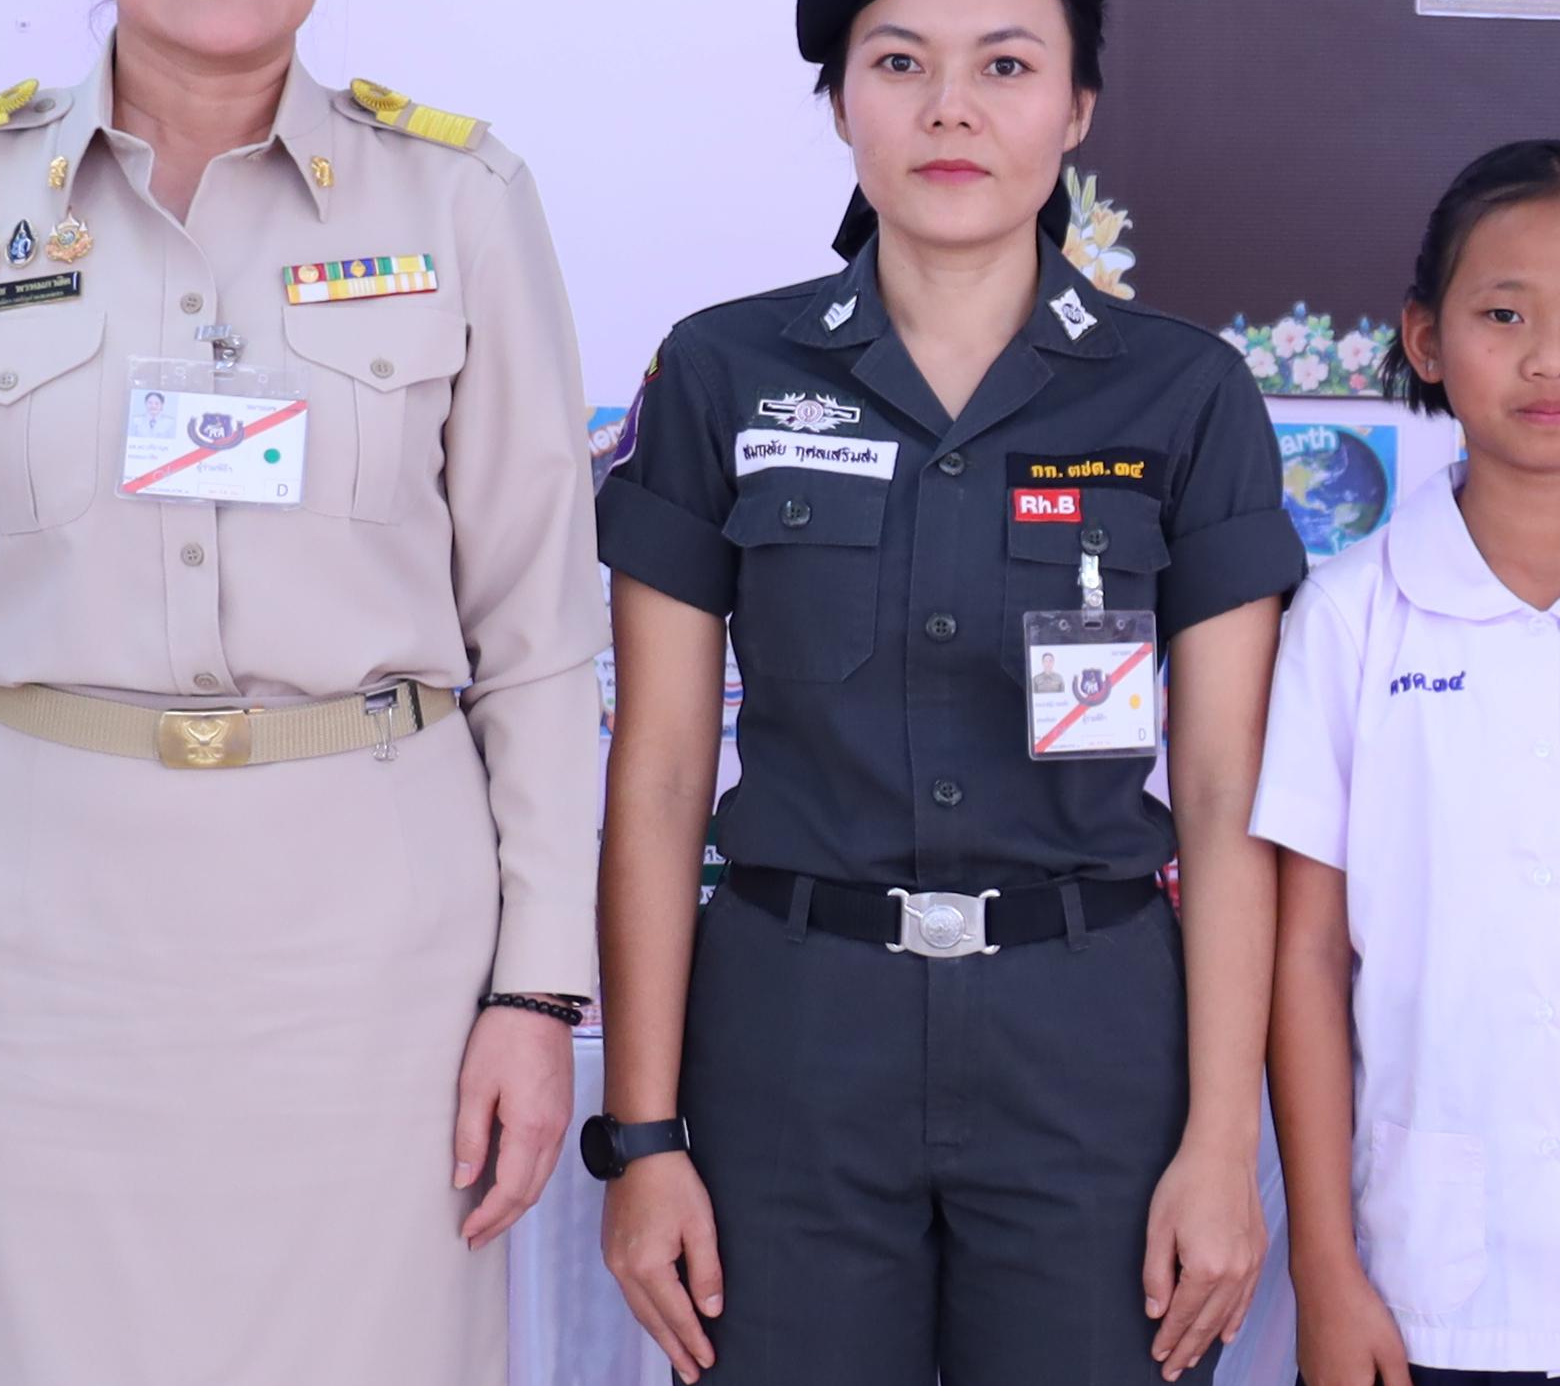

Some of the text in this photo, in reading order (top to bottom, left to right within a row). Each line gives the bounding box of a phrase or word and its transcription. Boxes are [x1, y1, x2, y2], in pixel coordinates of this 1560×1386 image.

[1281, 425, 1337, 455] arth
[1031, 460, 1145, 479] กก. ตชด. ๓๔
[276, 483, 289, 498] D
[1019, 494, 1076, 515] Rh.B
